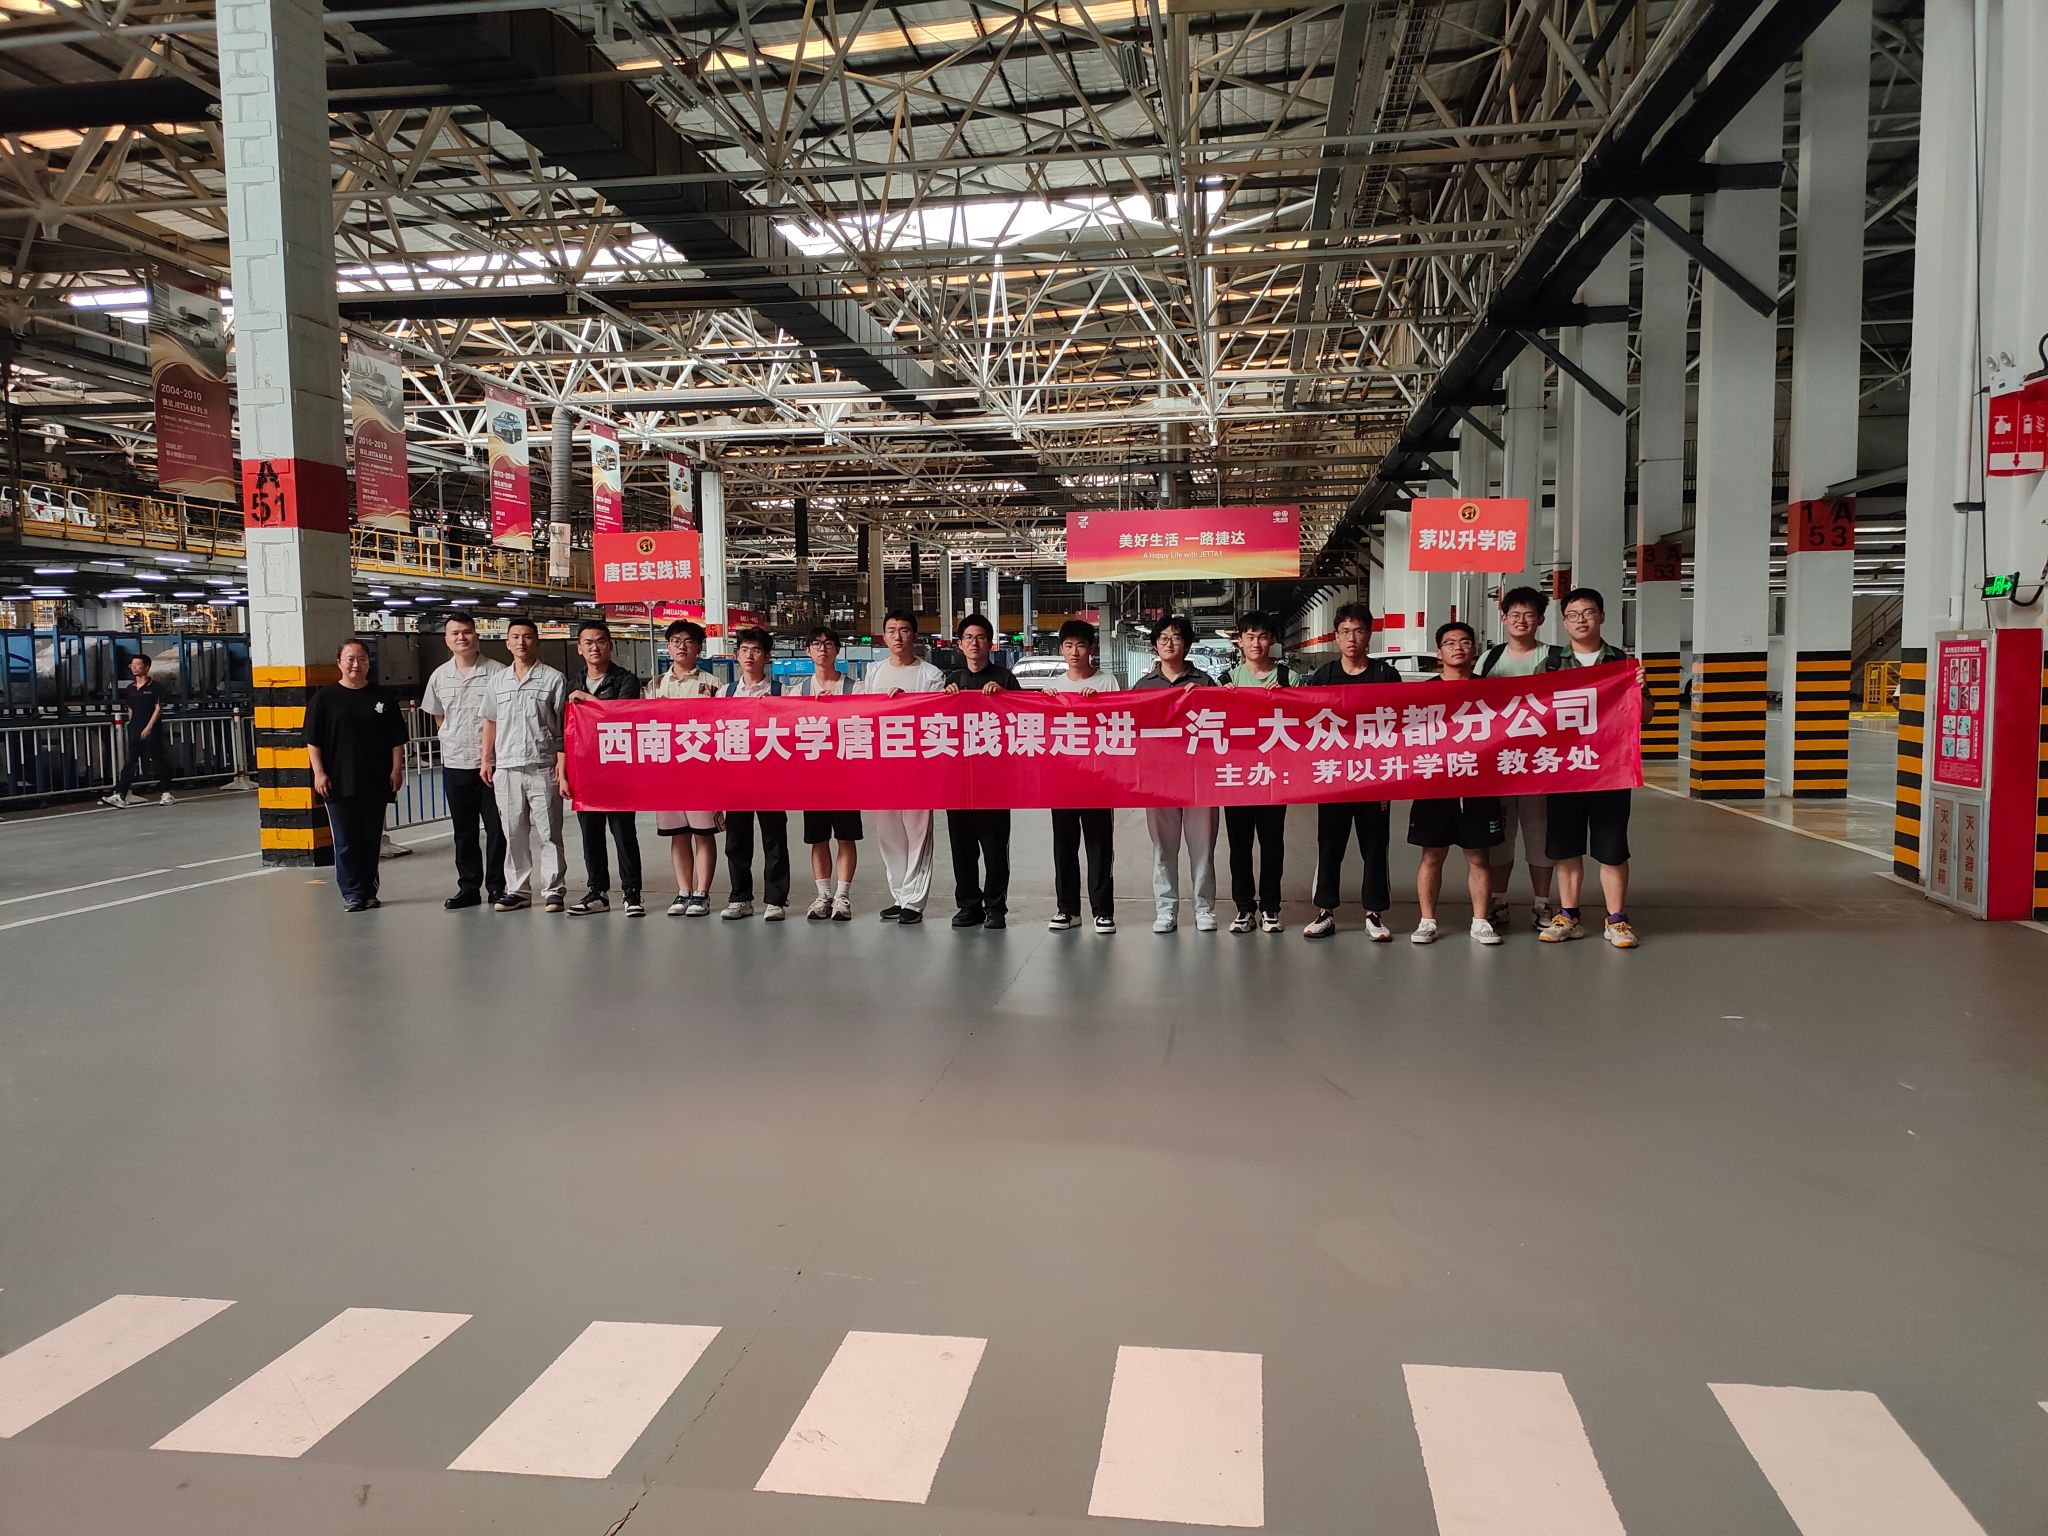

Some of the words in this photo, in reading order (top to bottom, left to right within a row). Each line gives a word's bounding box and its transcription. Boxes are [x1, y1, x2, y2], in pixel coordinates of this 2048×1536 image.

[160, 383, 202, 401] 2004-2010
[358, 436, 388, 450] 2010-2013
[256, 460, 280, 490] A
[251, 492, 286, 522] 51
[1801, 501, 1813, 524] 1
[1119, 533, 1179, 549] 美好生活
[1184, 530, 1246, 546] 一路捷达
[1418, 528, 1518, 552] 茅以升学院
[1809, 526, 1848, 548] 53
[1149, 551, 1169, 560] Happy
[1170, 549, 1183, 558] Life
[1184, 549, 1198, 558] with
[603, 559, 692, 583] 唐臣实践课
[596, 687, 1600, 764] 西南交通大学唐臣实践课走进一汽-大众成都分公司
[1312, 750, 1480, 785] 茅以升学院
[1496, 744, 1602, 776] 教务处
[1937, 808, 1950, 885] 灭火器箱
[1964, 815, 1976, 894] 灭火器箱
